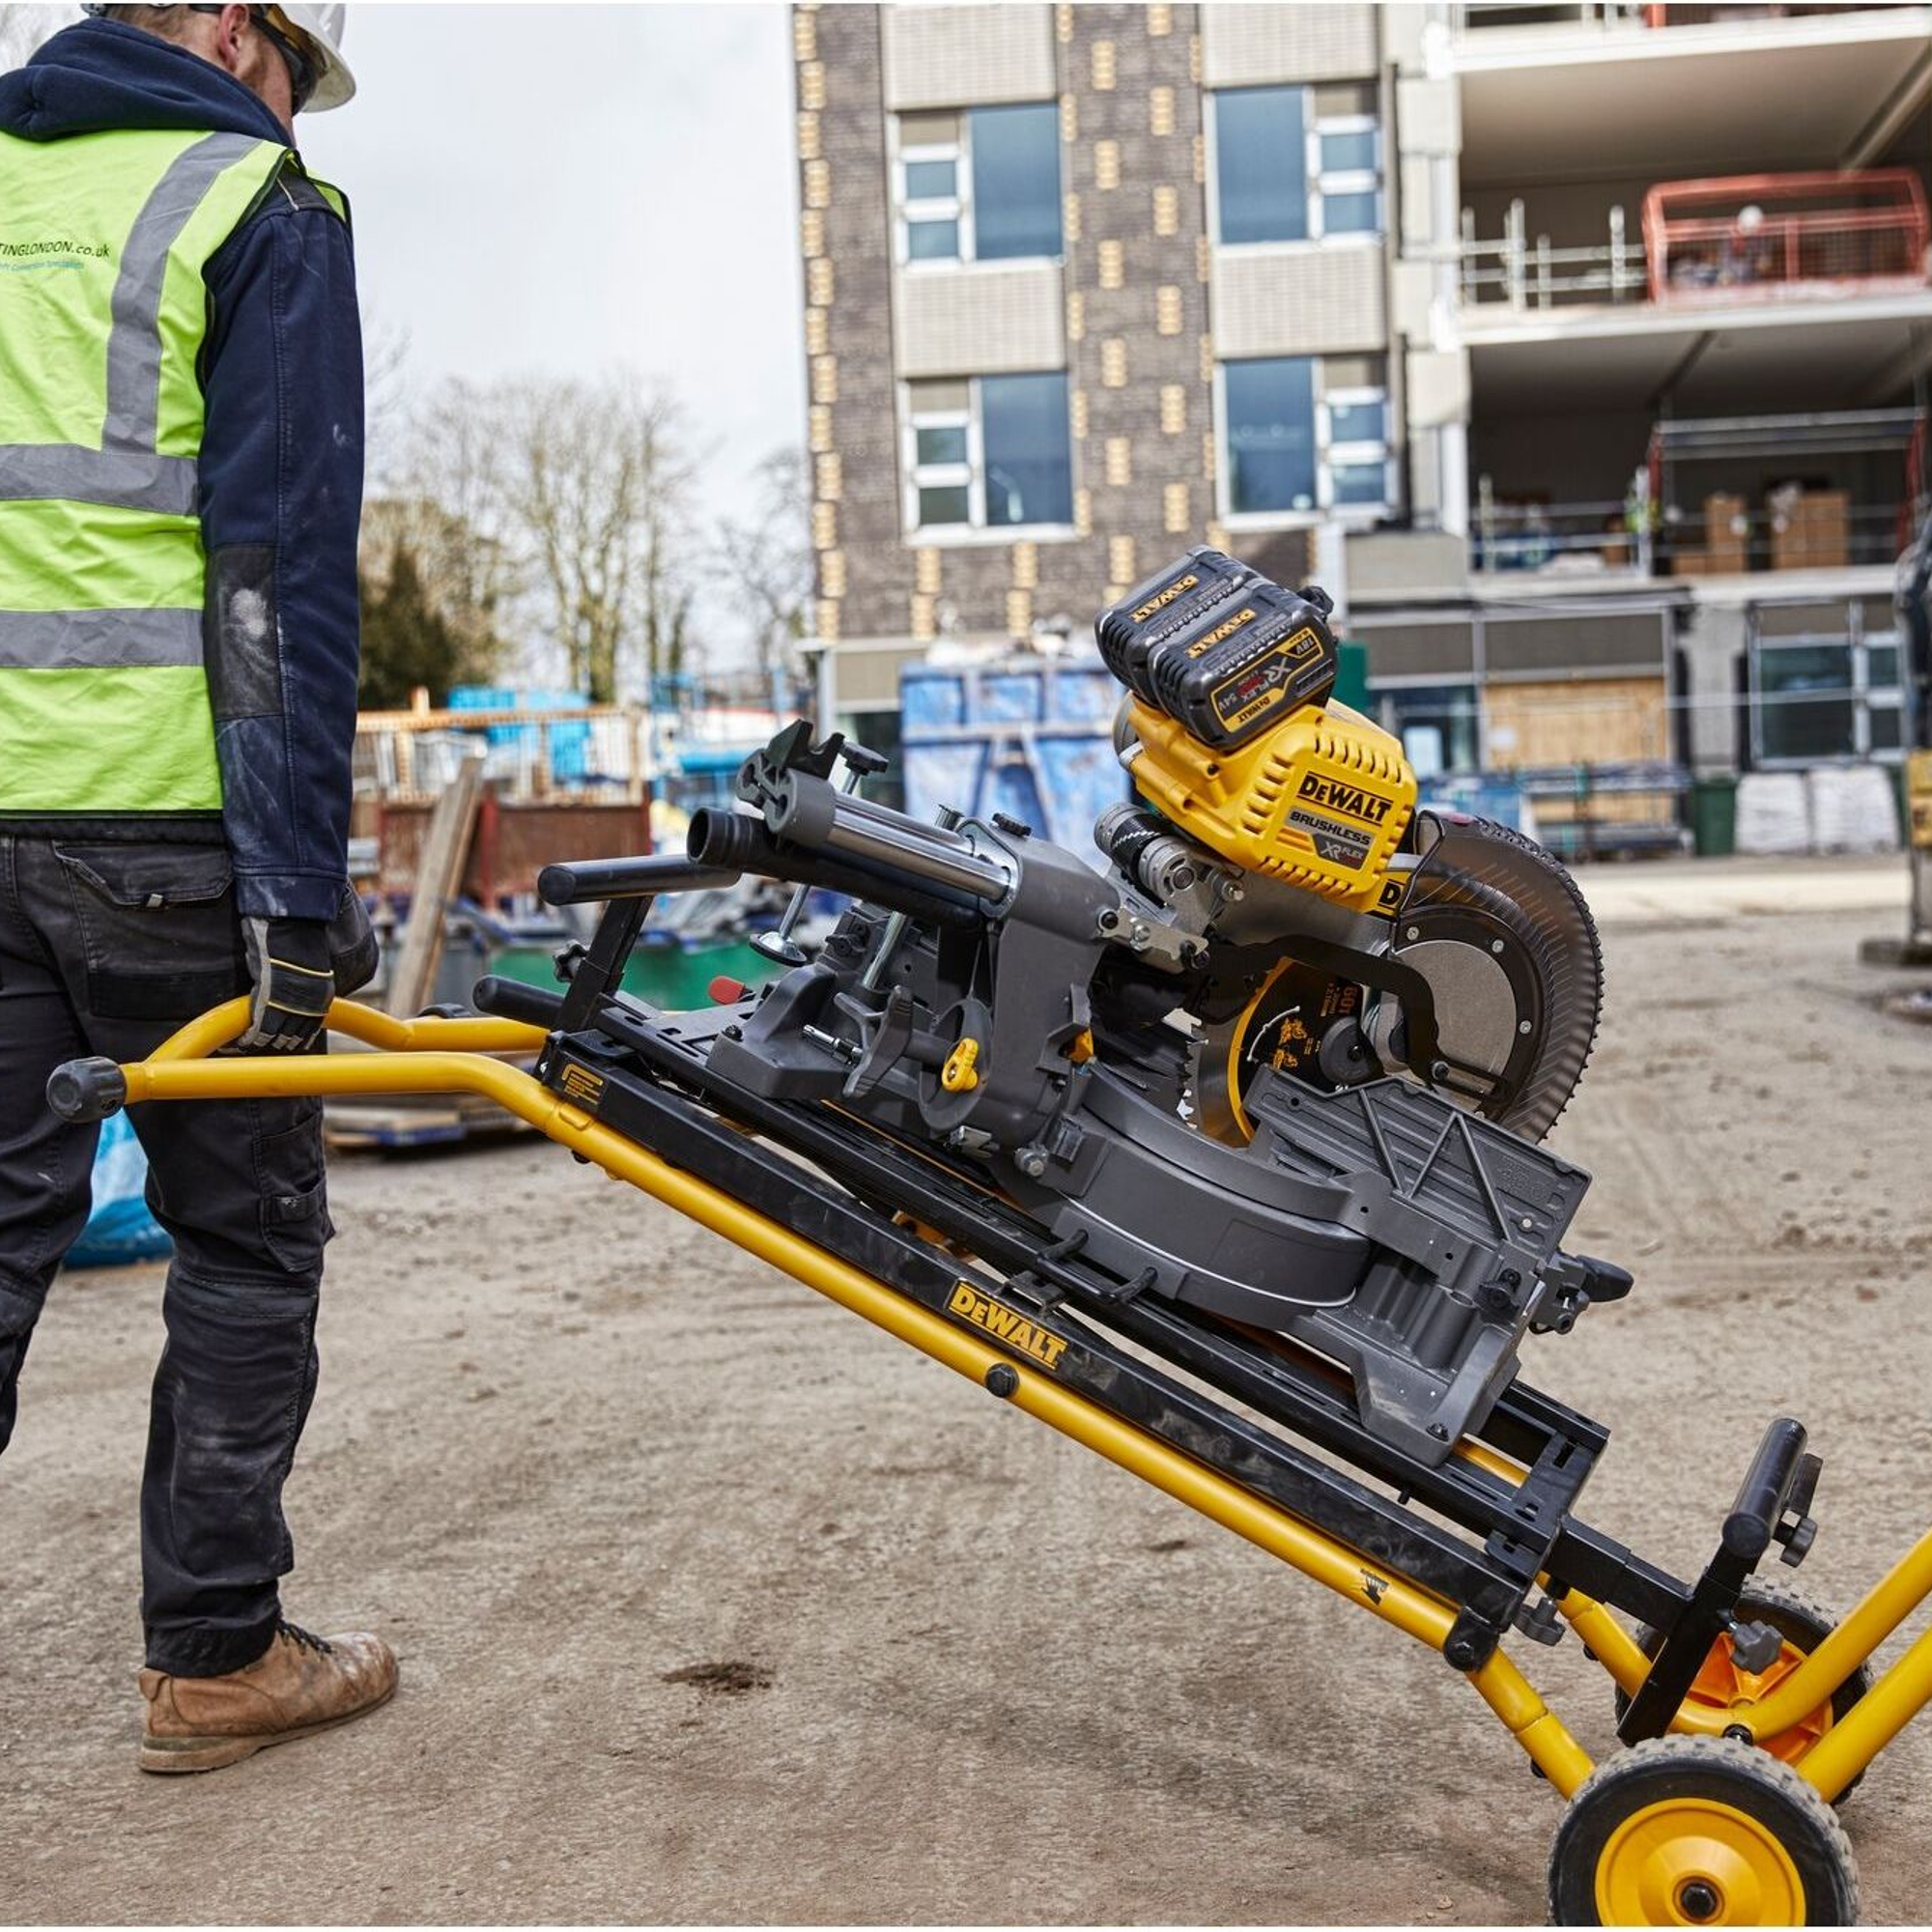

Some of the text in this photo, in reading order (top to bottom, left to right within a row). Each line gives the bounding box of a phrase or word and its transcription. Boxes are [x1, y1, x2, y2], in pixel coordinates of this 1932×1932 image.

[1129, 575, 1199, 623] DEWALT
[1185, 610, 1257, 658] DEWALT
[1295, 637, 1315, 655] 18V
[1264, 657, 1292, 683] XR
[1218, 693, 1237, 711] 54V
[1236, 696, 1271, 723] DEWALT
[1297, 774, 1393, 824] DEWALT
[1290, 810, 1372, 846] BRUSHLESS
[1321, 840, 1343, 861] XR
[949, 1284, 1067, 1368] DEWALT
